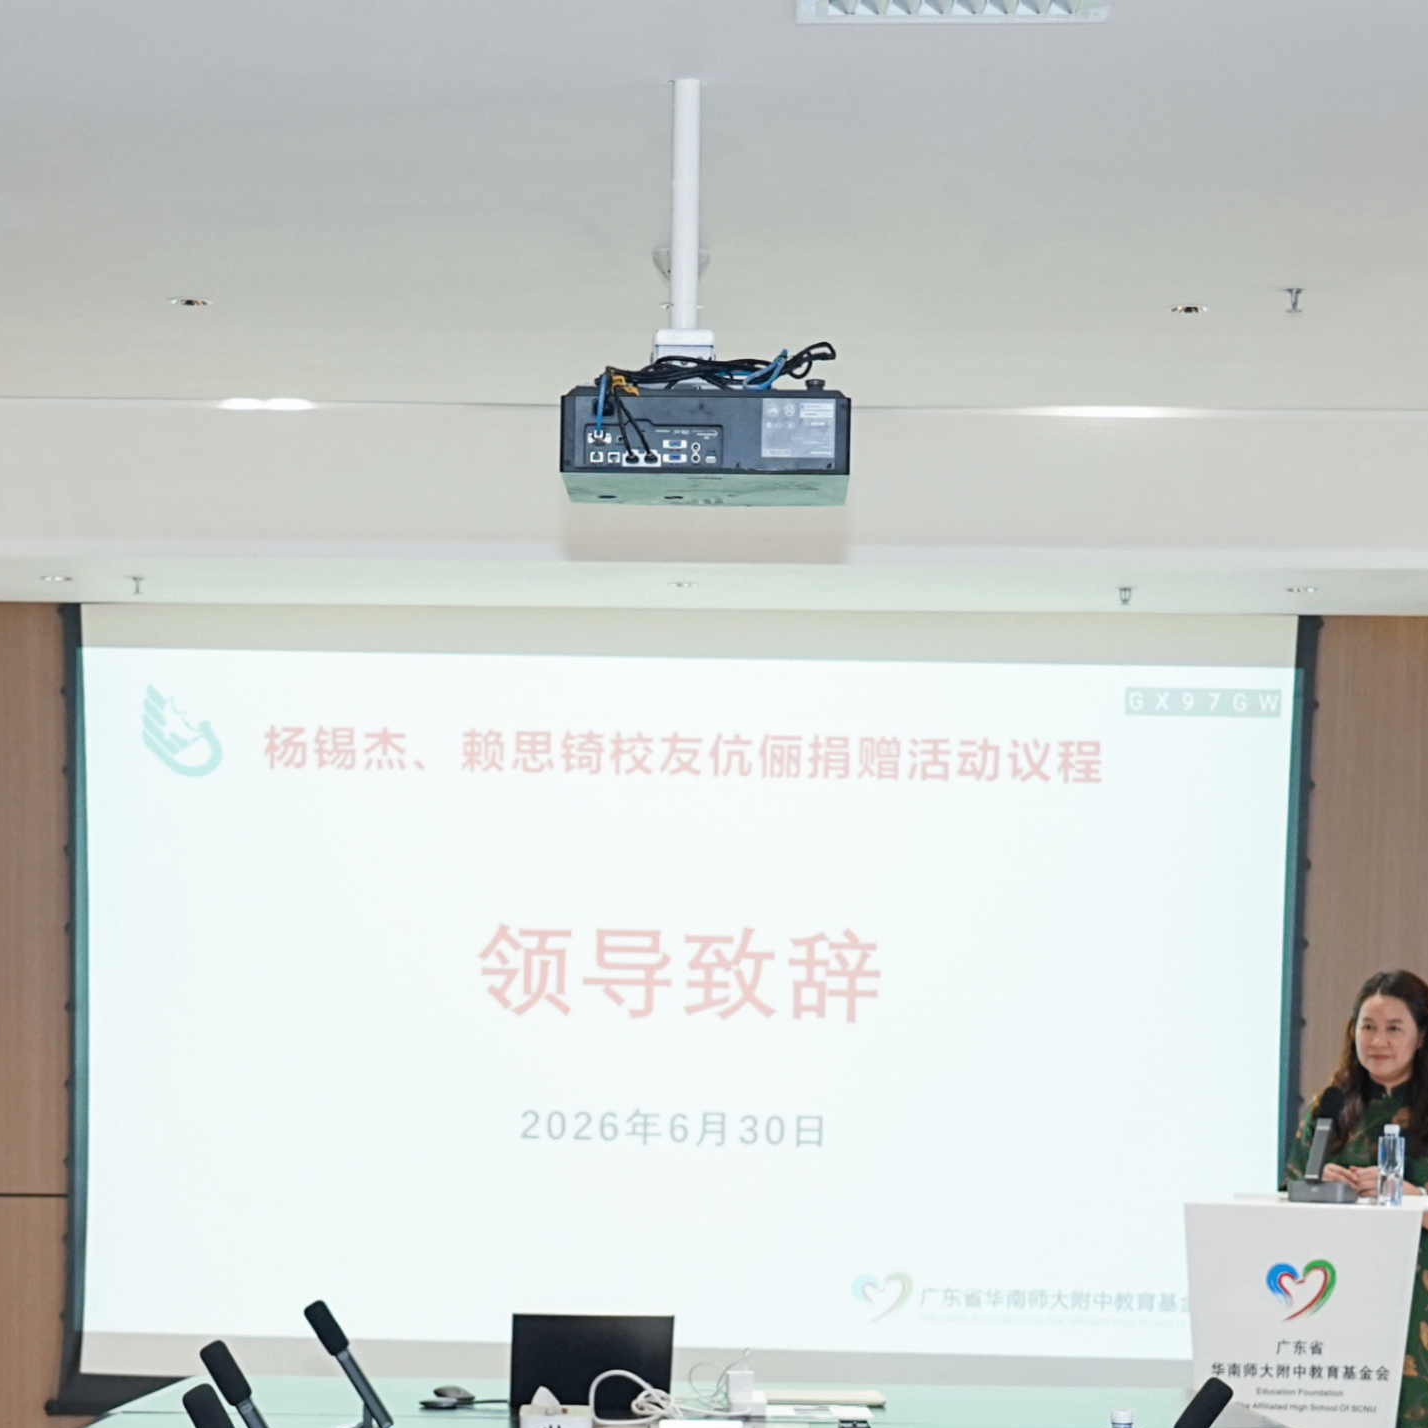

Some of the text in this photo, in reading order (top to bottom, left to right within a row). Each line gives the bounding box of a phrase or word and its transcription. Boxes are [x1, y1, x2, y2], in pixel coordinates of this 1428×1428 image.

[478, 922, 881, 1024] 领导致辞
[520, 1108, 824, 1149] 2026年6月30日
[1276, 1340, 1324, 1356] 广东省
[1211, 1362, 1390, 1382] 华南师大附中教育基金会
